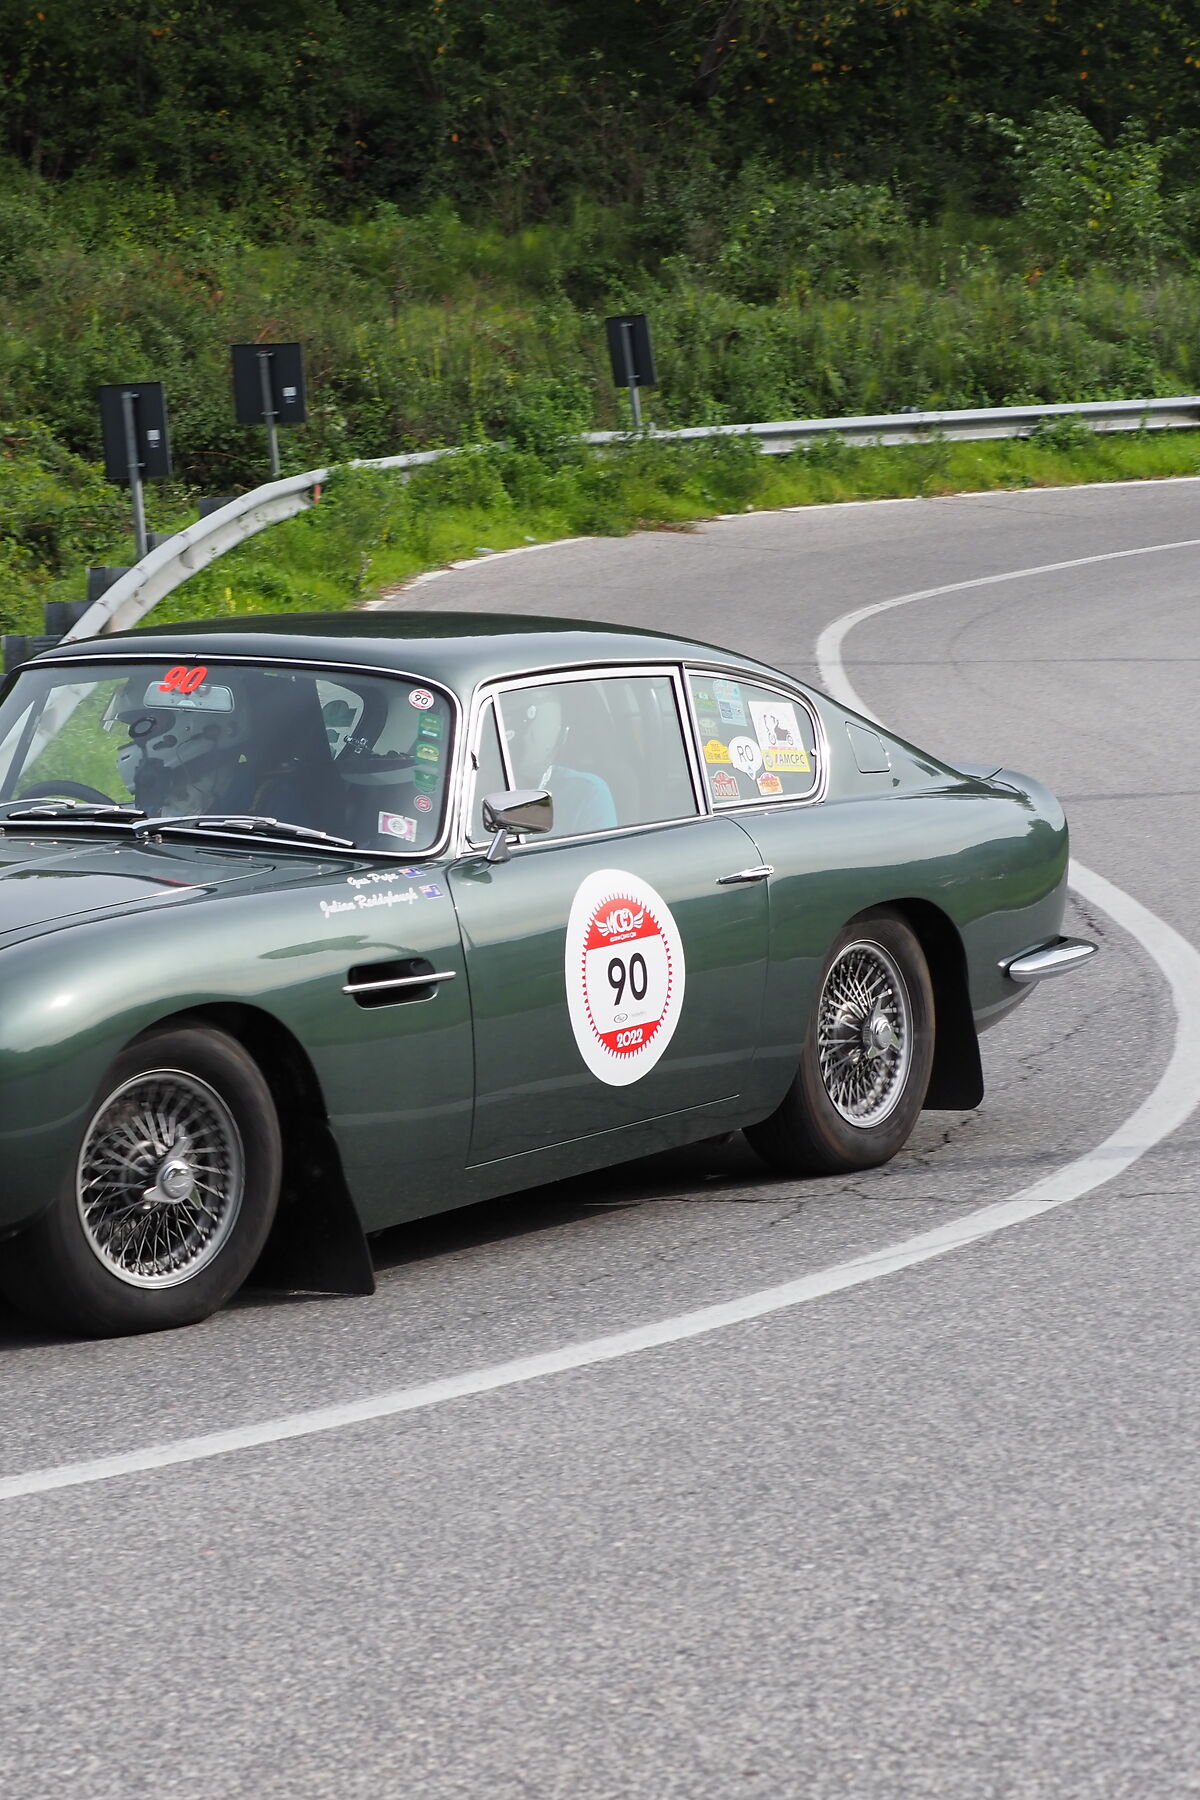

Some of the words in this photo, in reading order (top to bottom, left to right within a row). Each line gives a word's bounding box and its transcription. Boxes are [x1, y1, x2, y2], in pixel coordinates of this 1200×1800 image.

[158, 665, 208, 693] 90
[414, 694, 429, 705] 90
[736, 744, 754, 762] RO
[607, 952, 648, 1006] 90
[616, 1028, 643, 1048] 2022
